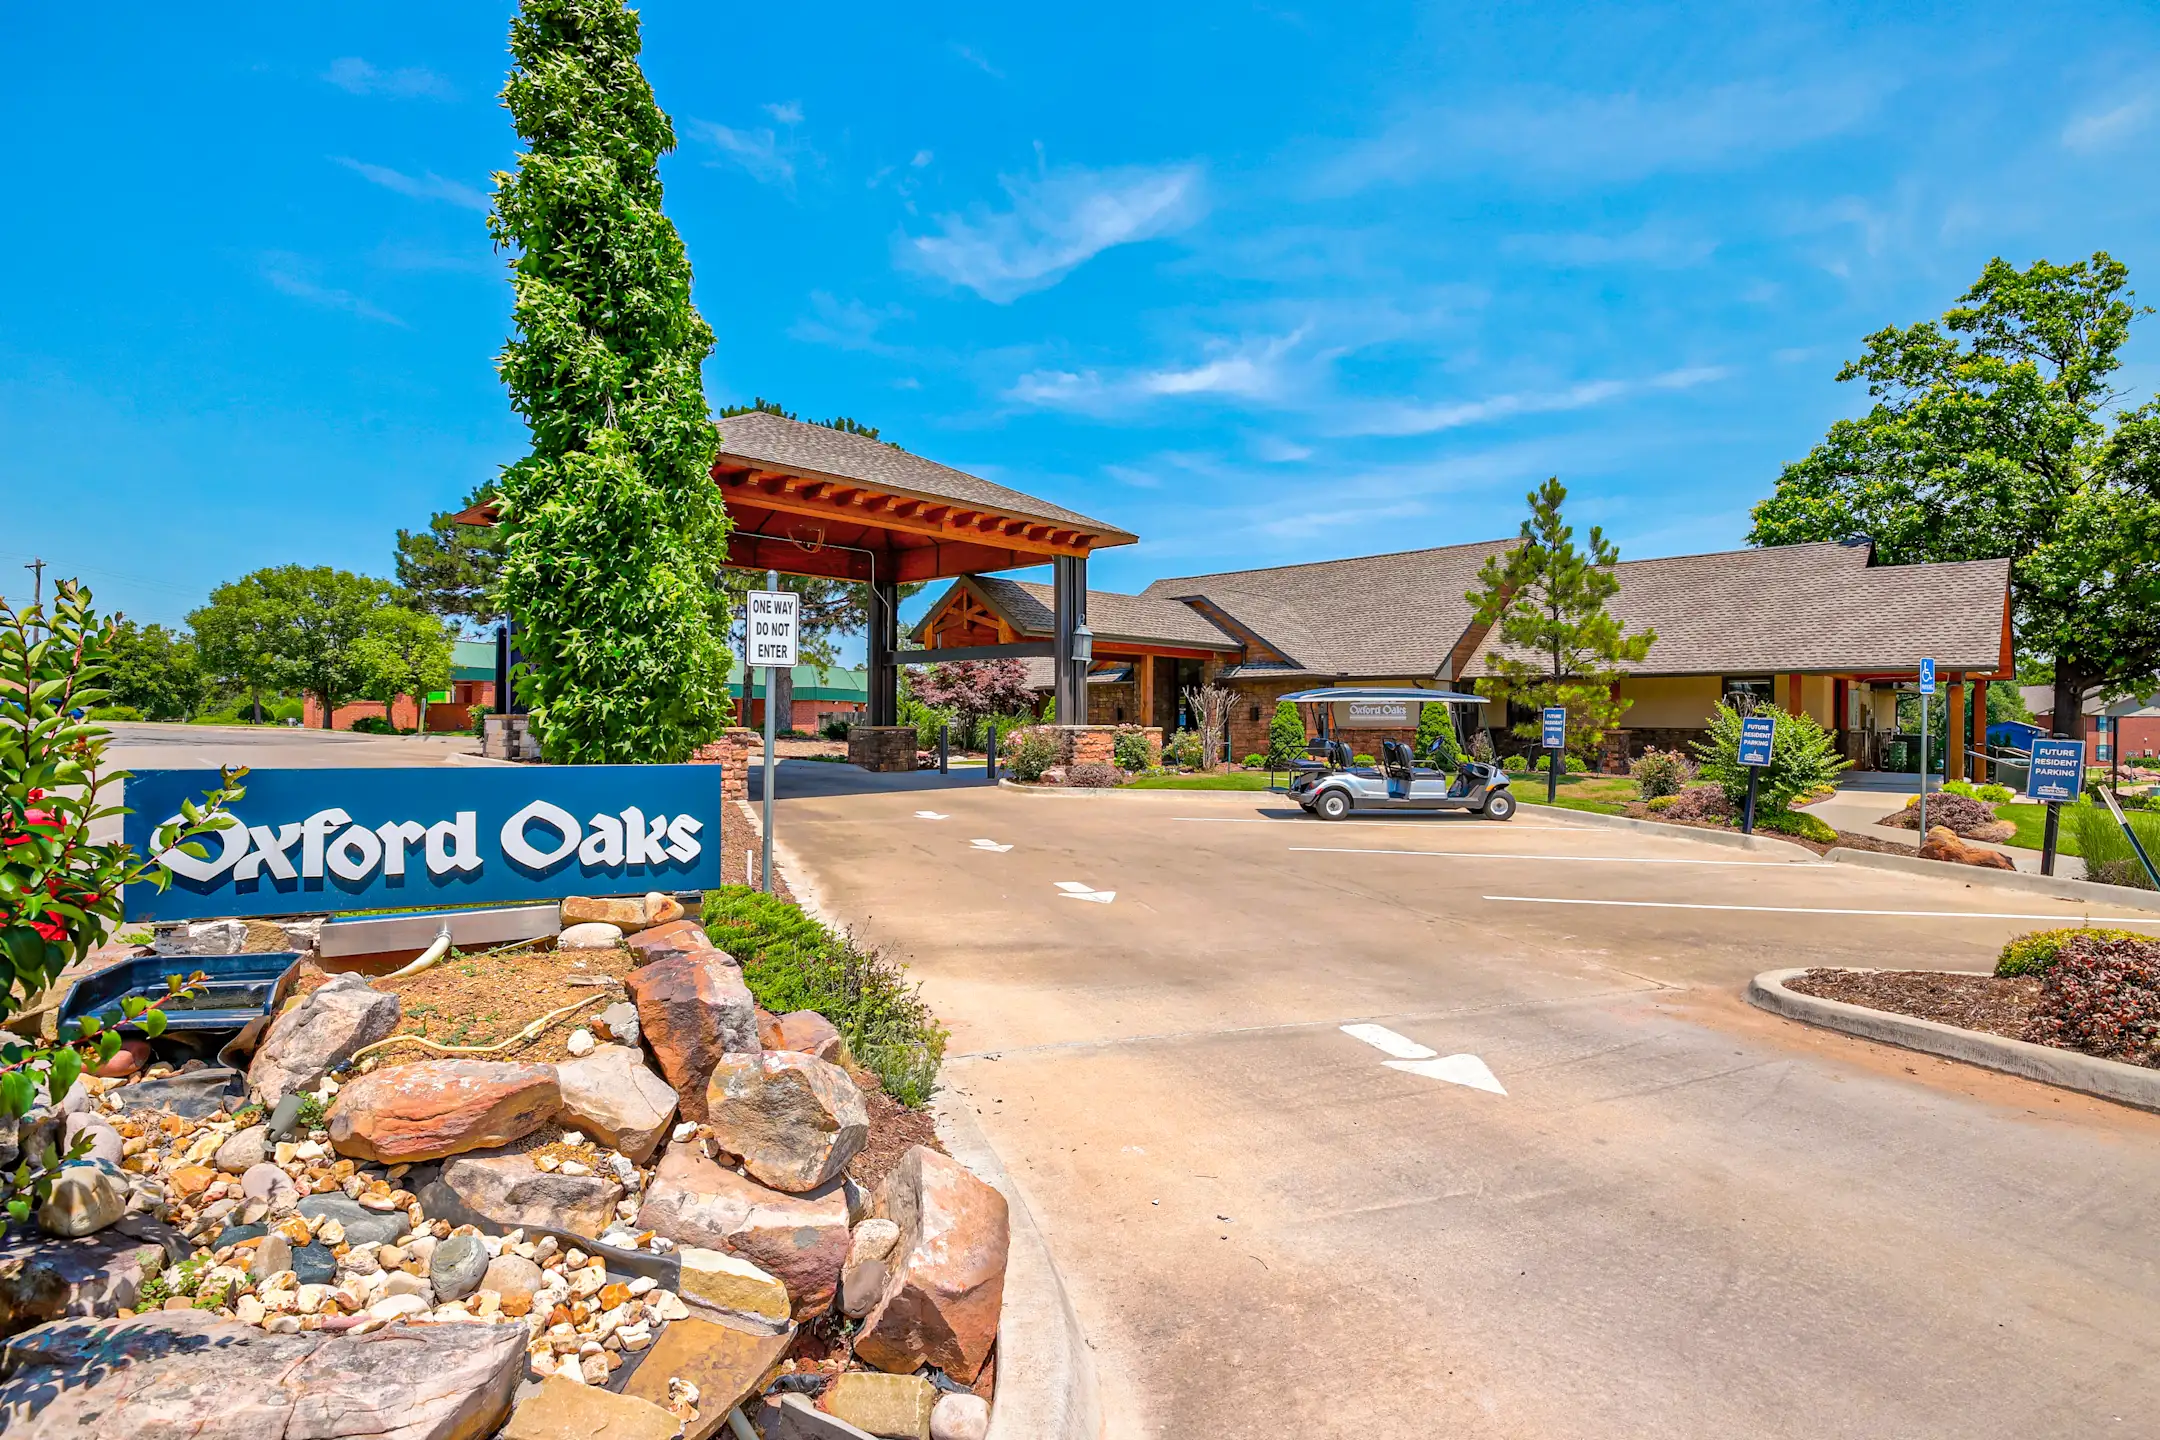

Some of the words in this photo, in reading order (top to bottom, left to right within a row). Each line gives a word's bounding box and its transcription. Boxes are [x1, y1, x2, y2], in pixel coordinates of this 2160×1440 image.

[753, 600, 771, 613] ONE
[774, 601, 793, 615] WAY
[756, 622, 768, 635] DO
[772, 623, 789, 636] NOT
[758, 644, 787, 658] ENTER
[1350, 705, 1381, 714] Oxford
[1383, 705, 1406, 714] Oaks
[2040, 748, 2075, 756] FUTURE
[2034, 758, 2078, 767] RESIDENT
[2035, 768, 2075, 777] PARKING
[150, 804, 484, 882] Oxford
[501, 800, 703, 869] Oaks
